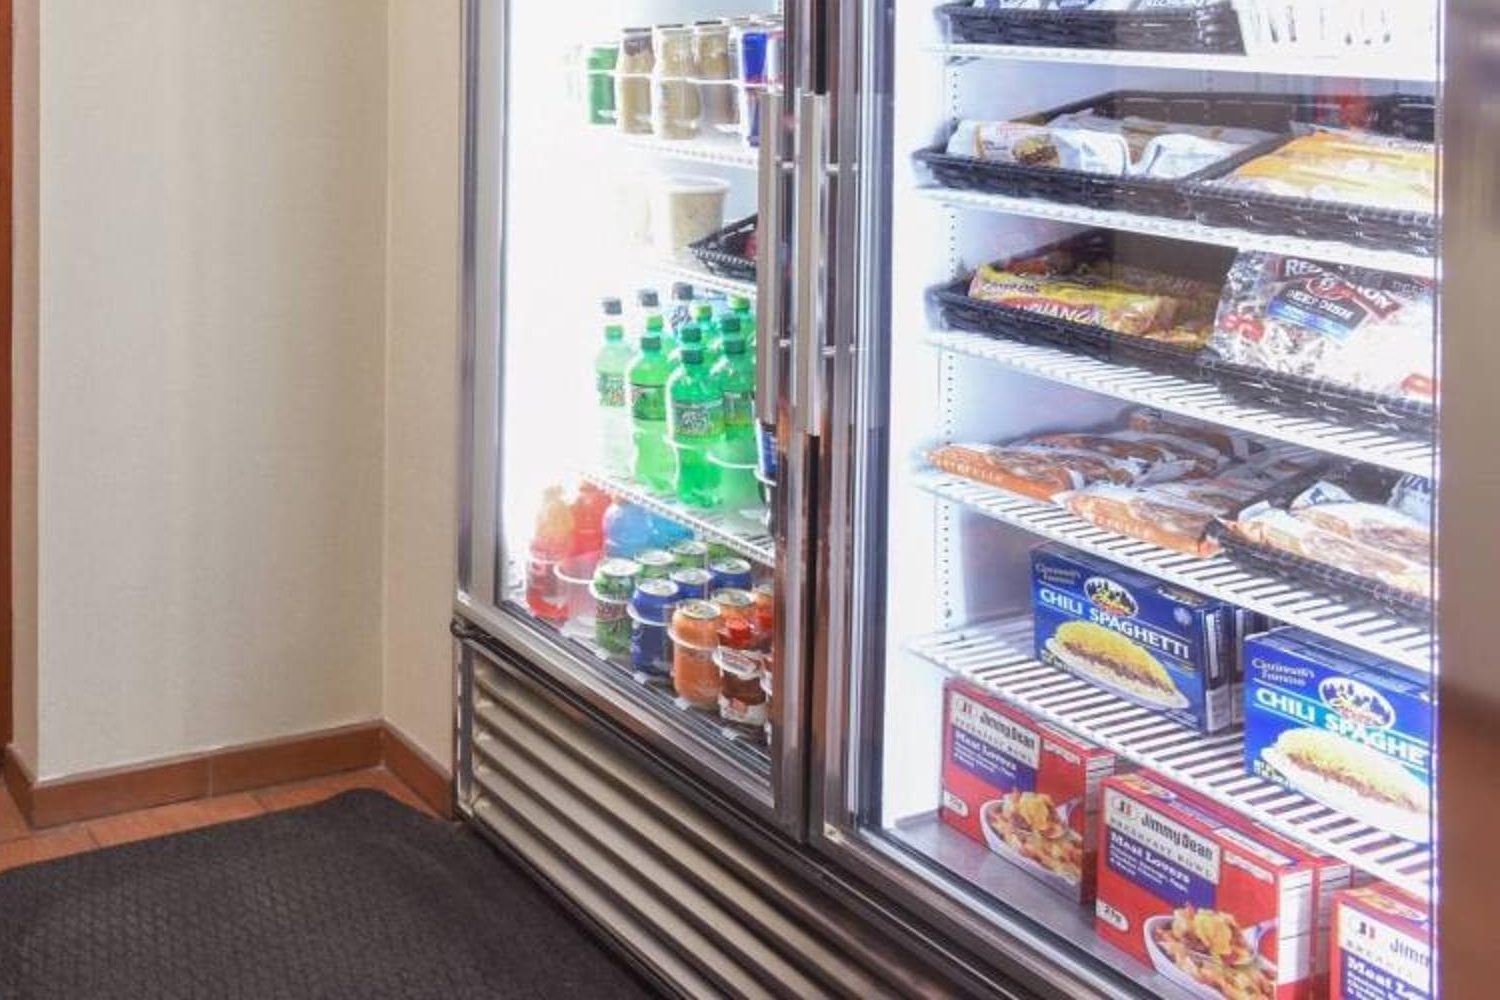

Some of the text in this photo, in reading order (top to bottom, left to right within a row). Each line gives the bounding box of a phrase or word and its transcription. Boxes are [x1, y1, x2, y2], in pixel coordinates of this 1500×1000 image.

[1040, 589, 1083, 615] CHILI
[1089, 607, 1190, 659] SPAGHETTI
[1256, 687, 1316, 722] CHILI
[1110, 830, 1144, 858] Meat
[1145, 853, 1191, 884] Lovers
